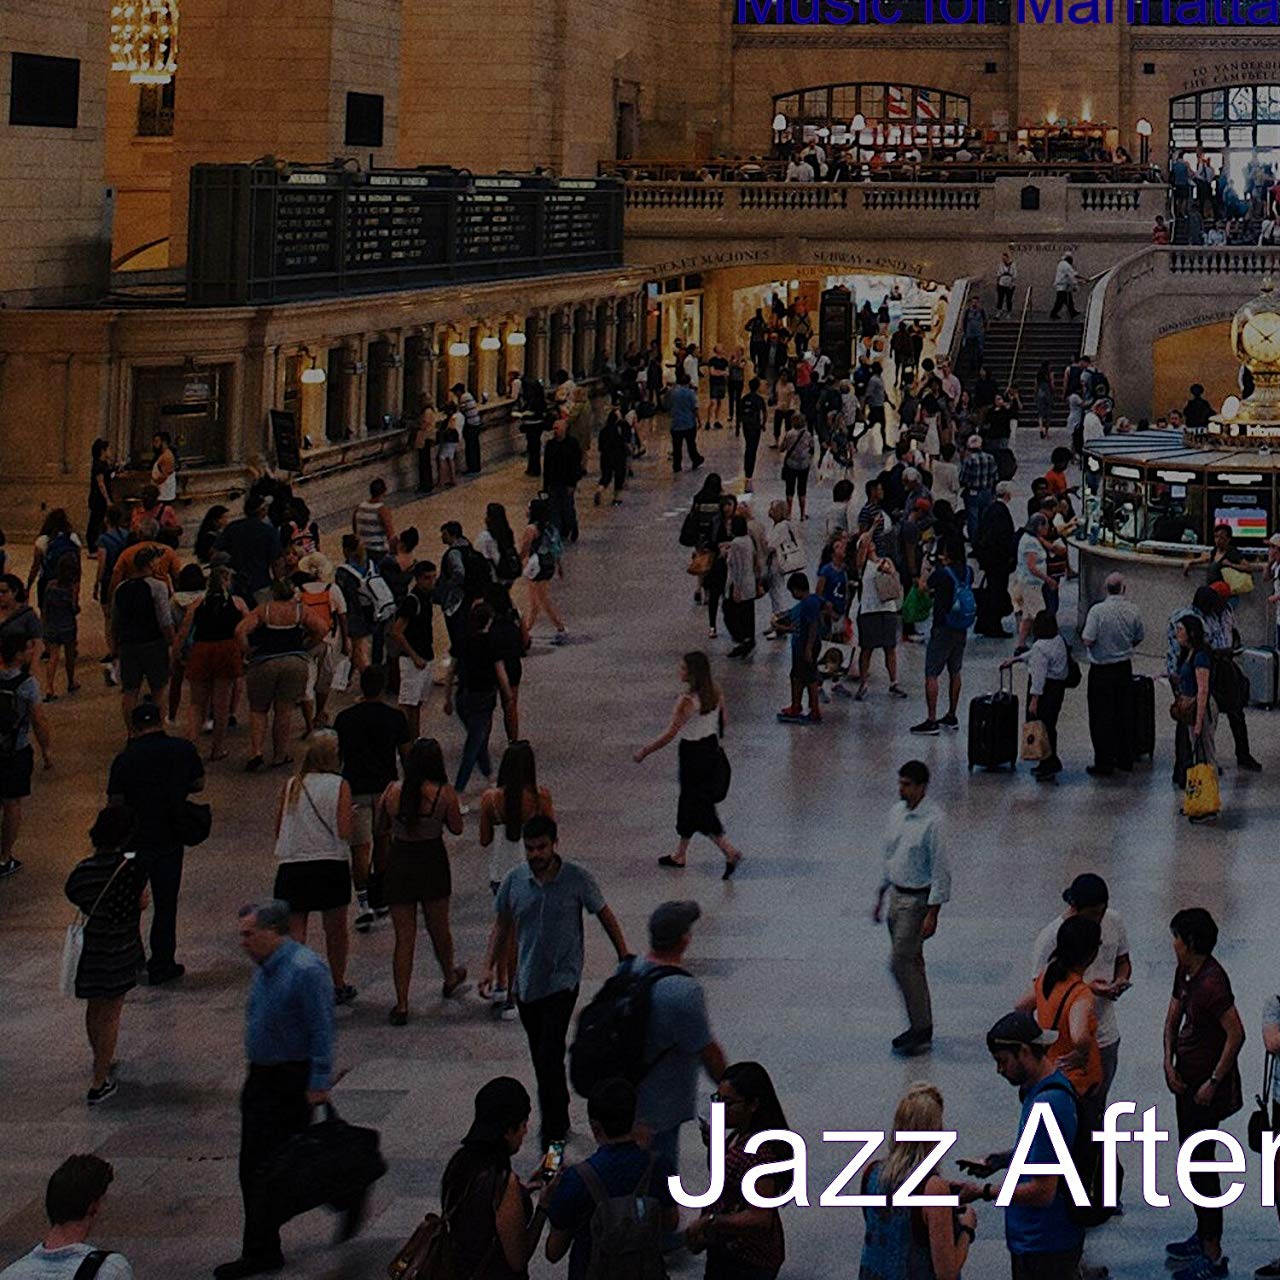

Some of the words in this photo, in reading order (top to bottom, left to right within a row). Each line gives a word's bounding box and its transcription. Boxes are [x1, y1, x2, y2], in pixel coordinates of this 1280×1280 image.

[1192, 68, 1207, 77] TO
[1213, 71, 1276, 82] CAMPBELL
[701, 250, 770, 265] MACHINES
